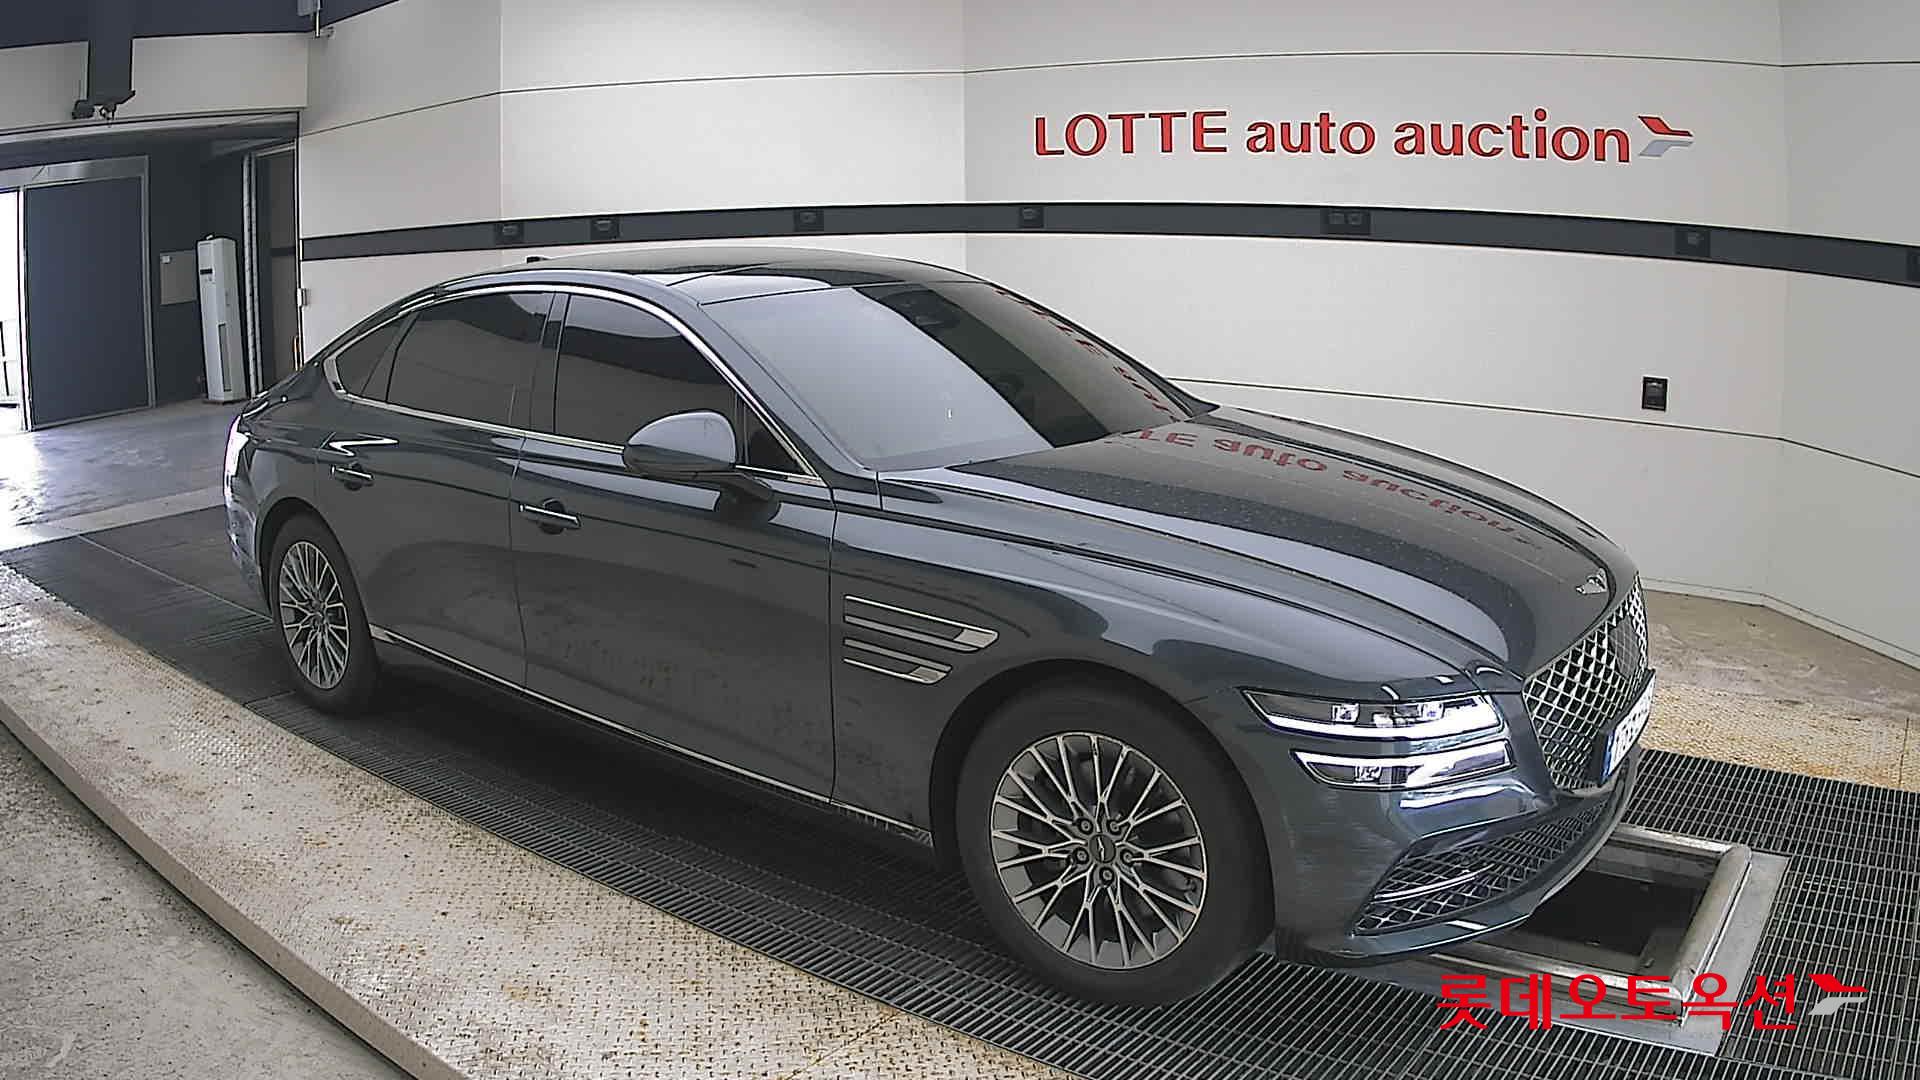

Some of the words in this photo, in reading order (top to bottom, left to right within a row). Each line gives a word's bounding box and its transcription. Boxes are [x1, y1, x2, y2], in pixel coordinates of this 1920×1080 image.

[1034, 111, 1228, 156] LOTTE
[1245, 111, 1376, 155] auto
[1393, 107, 1631, 163] auction
